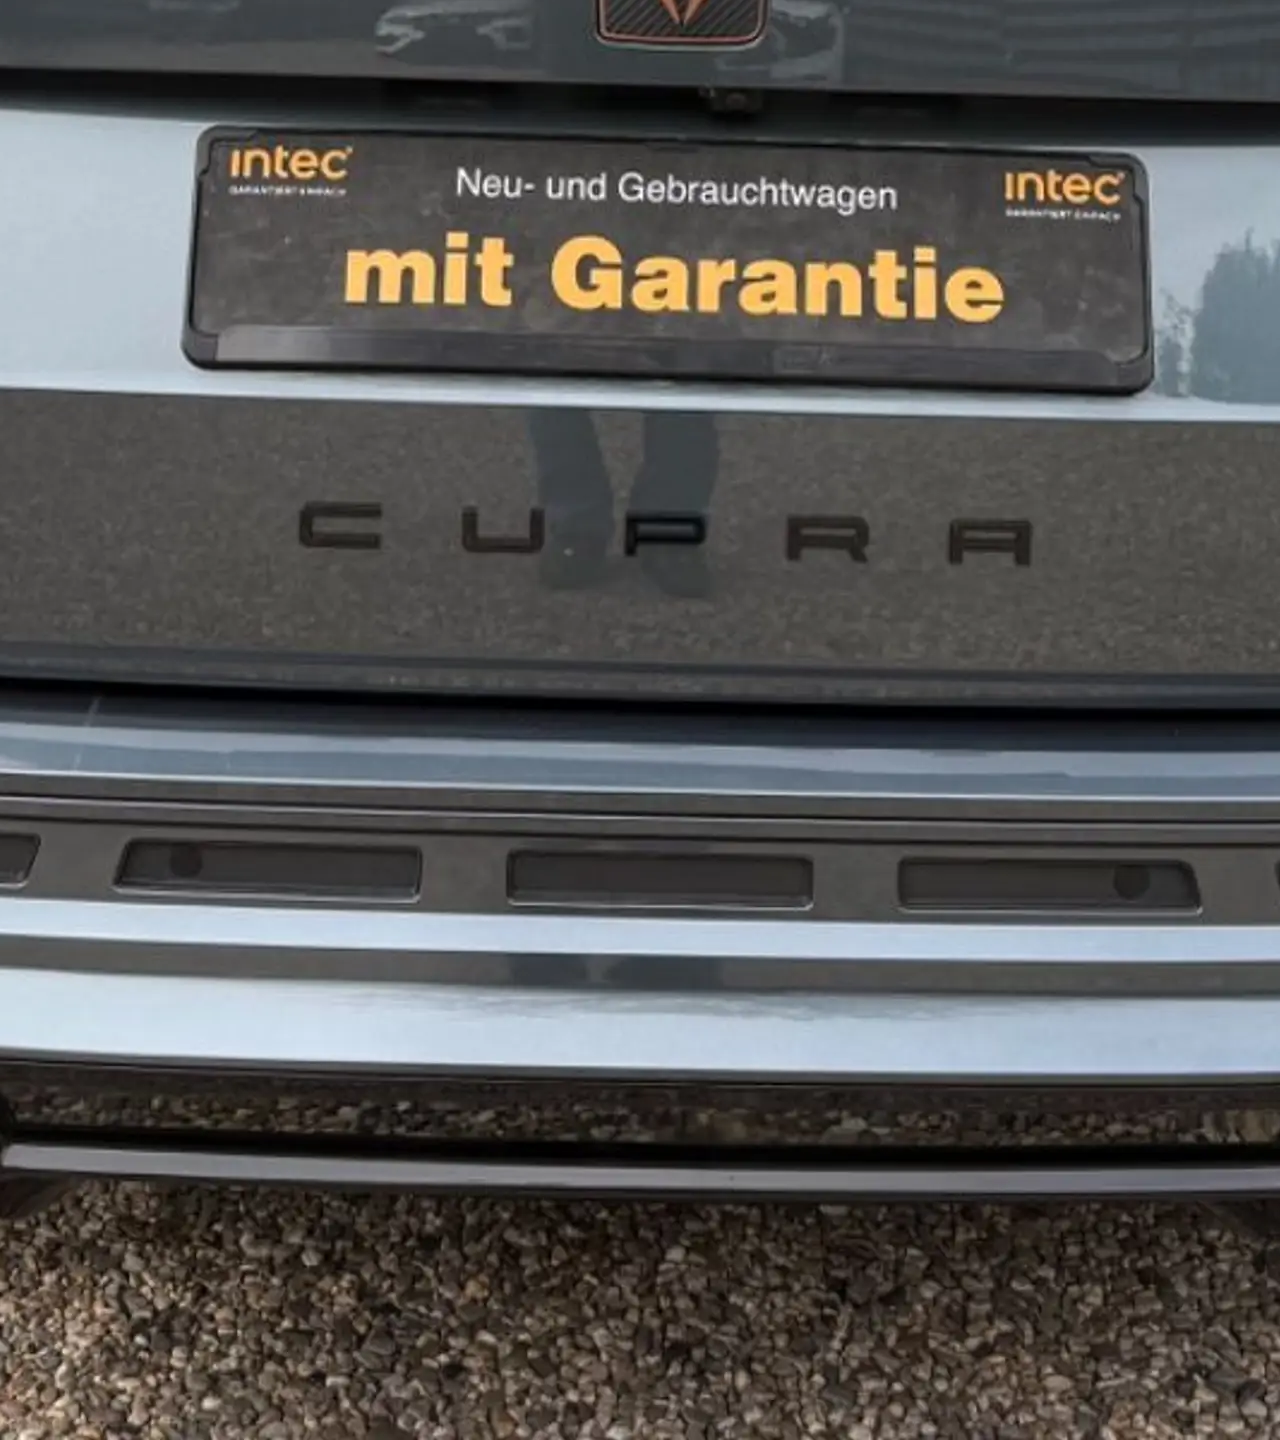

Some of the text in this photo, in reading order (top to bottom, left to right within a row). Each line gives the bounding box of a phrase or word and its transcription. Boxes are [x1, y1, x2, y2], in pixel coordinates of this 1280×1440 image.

[230, 144, 352, 180] intec
[1004, 168, 1124, 206] intec
[455, 166, 899, 218] Neu- und Gebrauchtwagen
[346, 233, 1006, 324] mit Garantie
[298, 500, 1033, 566] CUPRA
